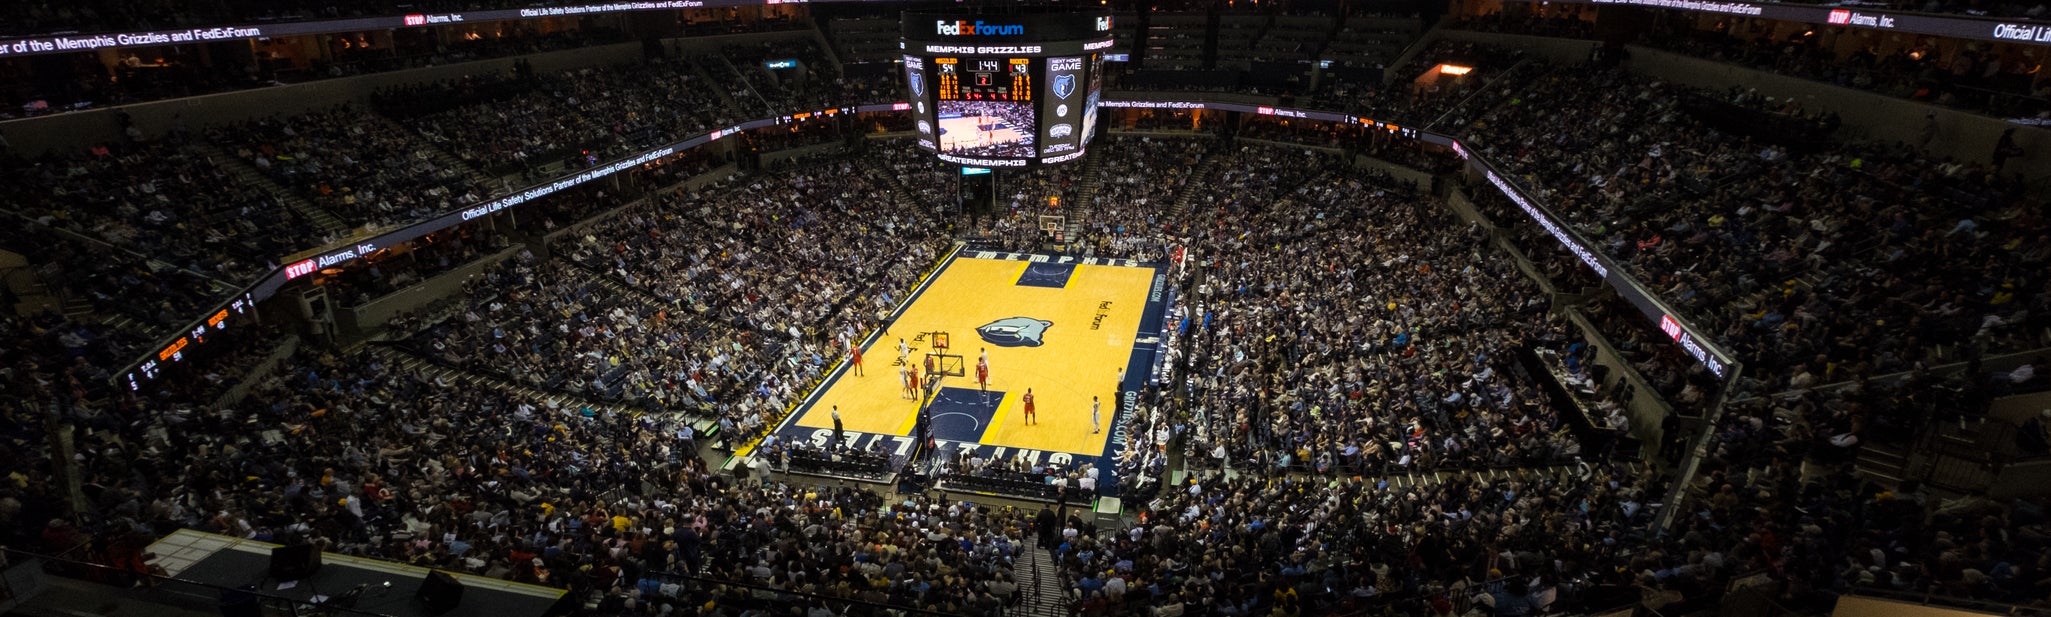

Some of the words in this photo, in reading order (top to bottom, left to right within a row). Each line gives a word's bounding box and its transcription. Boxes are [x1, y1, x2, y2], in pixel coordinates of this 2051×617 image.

[406, 16, 424, 25] STOP
[426, 14, 451, 24] Alarms,
[451, 13, 463, 22] Inc.
[1830, 12, 1848, 23] STOP
[1849, 13, 1877, 28] Alarms,
[1880, 14, 1894, 28] Inc.
[937, 20, 1023, 35] FedExForum
[1993, 23, 2035, 41] Official
[14, 40, 28, 52] of
[30, 39, 53, 52] the
[55, 35, 116, 50] Memphis
[117, 32, 170, 46] Grizzlies
[172, 31, 192, 41] and
[193, 26, 260, 40] FedExForum
[977, 46, 1041, 54] GRIZZLIES
[906, 61, 923, 70] GAME
[942, 64, 953, 73] 54
[979, 61, 997, 70] 1:44
[1015, 64, 1026, 73] 43
[1051, 62, 1081, 71] GAME
[981, 77, 987, 85] 2
[462, 206, 488, 221] Official
[488, 202, 502, 213] Life
[502, 196, 524, 210] Safety
[524, 185, 554, 201] Solutions
[554, 180, 575, 192] Partner
[575, 175, 582, 184] of
[582, 173, 591, 182] the
[592, 166, 615, 179] Memphis
[287, 262, 314, 279] STOP
[319, 250, 357, 267] Alarms,
[358, 244, 376, 255] Inc.
[975, 251, 1138, 268] MEMPHIS
[1661, 317, 1679, 338] STOP
[1680, 332, 1707, 365] Alarms,
[1708, 355, 1722, 377] Inc.
[130, 381, 138, 391] 5
